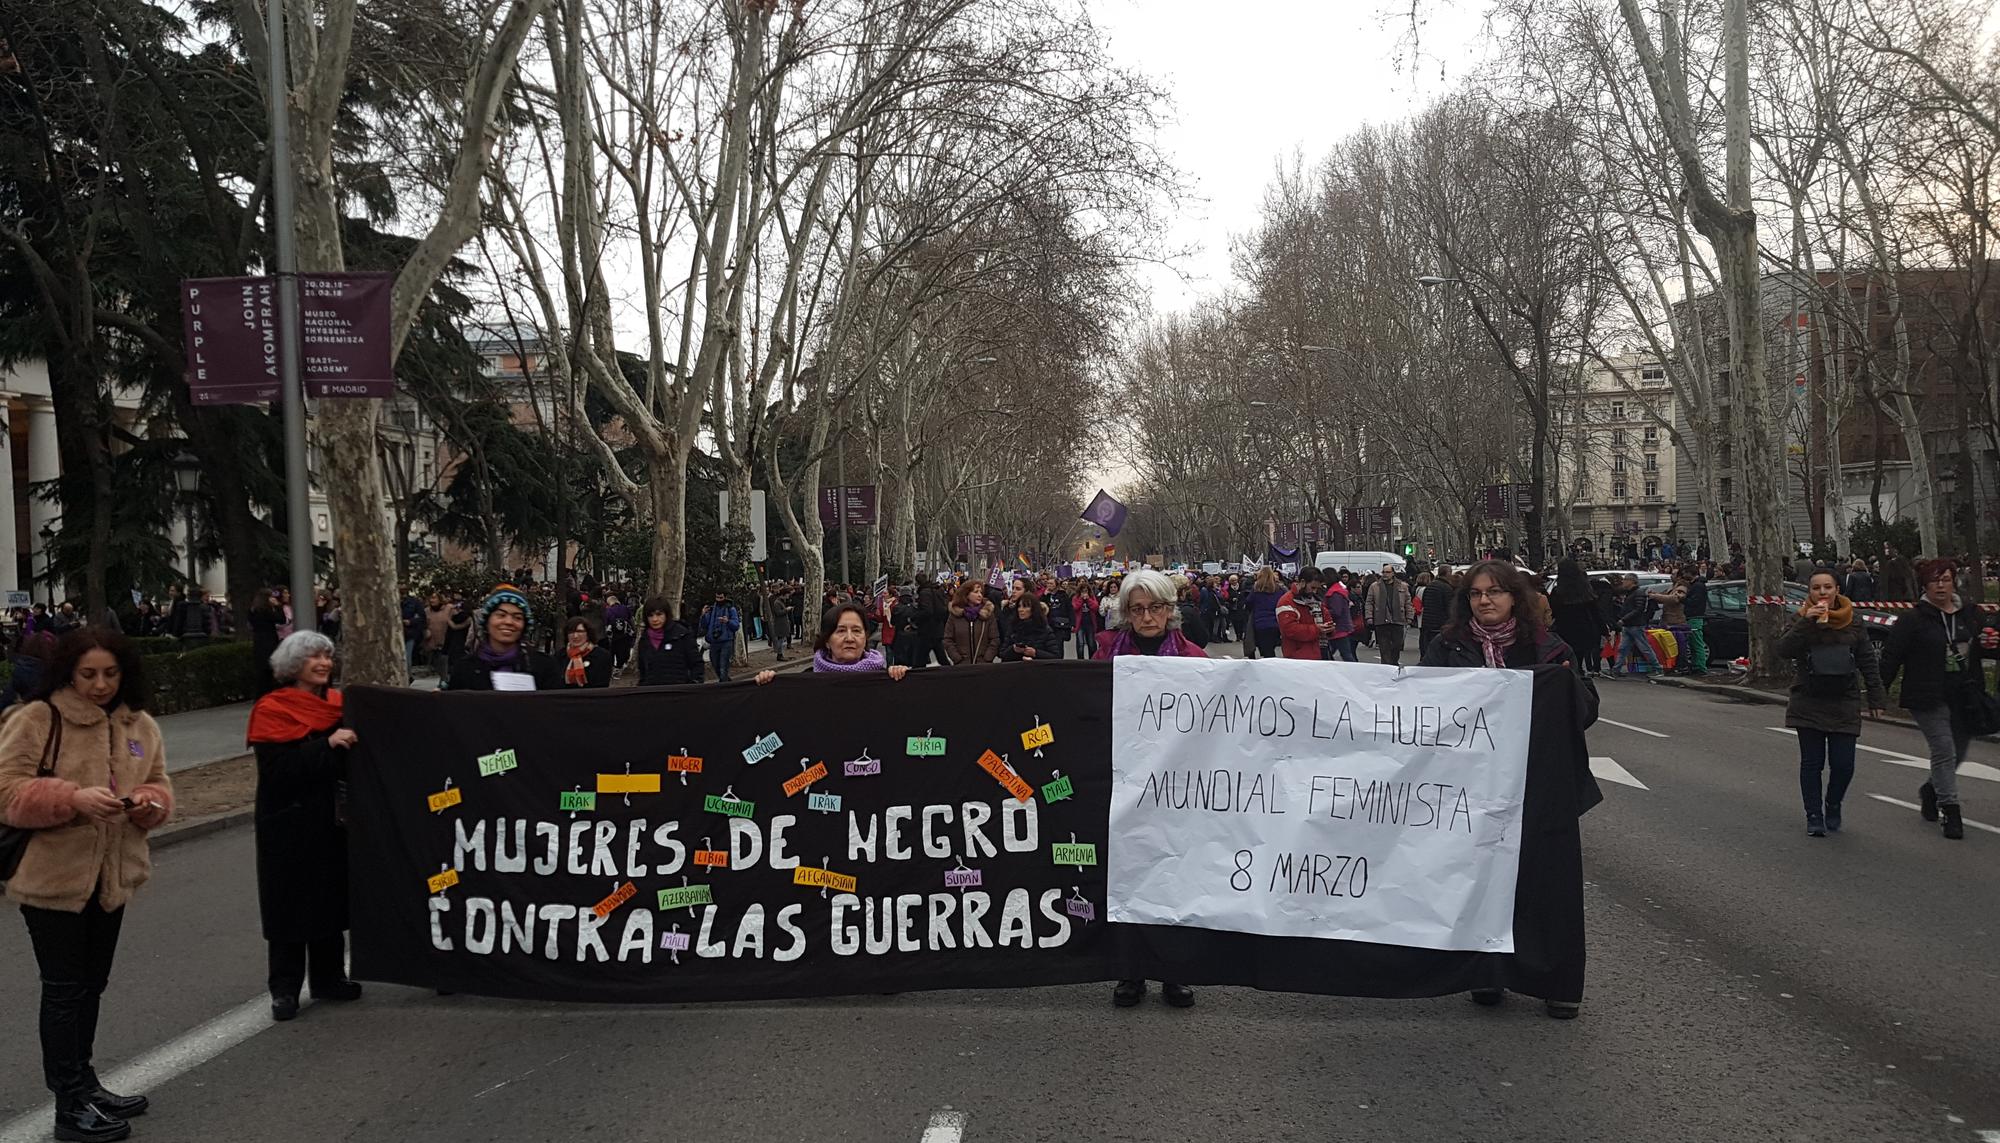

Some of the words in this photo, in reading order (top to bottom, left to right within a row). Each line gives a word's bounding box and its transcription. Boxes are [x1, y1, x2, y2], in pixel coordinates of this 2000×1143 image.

[242, 286, 256, 330] JOHN
[304, 310, 336, 318] MUSEO
[189, 288, 206, 380] PURPLE
[259, 284, 278, 376] AKOMFRAH
[305, 336, 364, 344] BORNEMISZA
[1137, 692, 1296, 738] APOYAMOS
[1312, 699, 1354, 742] LA
[1028, 729, 1049, 744] RCA
[912, 740, 942, 752] SIRIA
[481, 752, 515, 774] YEMEN
[671, 759, 701, 771] NIGER
[846, 762, 879, 774] CONGO
[785, 766, 826, 793] PAQUISTAN
[983, 754, 1028, 798] PALESTINA
[1046, 780, 1070, 798] MALI
[432, 792, 459, 808] CHAD
[563, 796, 590, 808] IRAK
[707, 797, 752, 814] UCRANIA
[812, 796, 838, 811] IRAK
[1136, 768, 1286, 815] MUNDIAL
[1308, 776, 1473, 834] FEMINISTA
[453, 817, 686, 877] MUJERES
[729, 815, 800, 872] DE
[848, 797, 1038, 863] NEGRO
[698, 852, 725, 864] LIBIA
[1054, 847, 1094, 864] ARMENIA
[798, 869, 855, 890] AFGANISTAN
[946, 872, 980, 885] SUDAN
[1230, 850, 1252, 893] 8
[1270, 852, 1368, 898] MARZO
[596, 884, 635, 915] MYANMAR
[1068, 902, 1091, 914] CHAD
[428, 897, 654, 964] CONTRA
[696, 903, 806, 962] LAS
[830, 888, 1072, 957] GUERRAS
